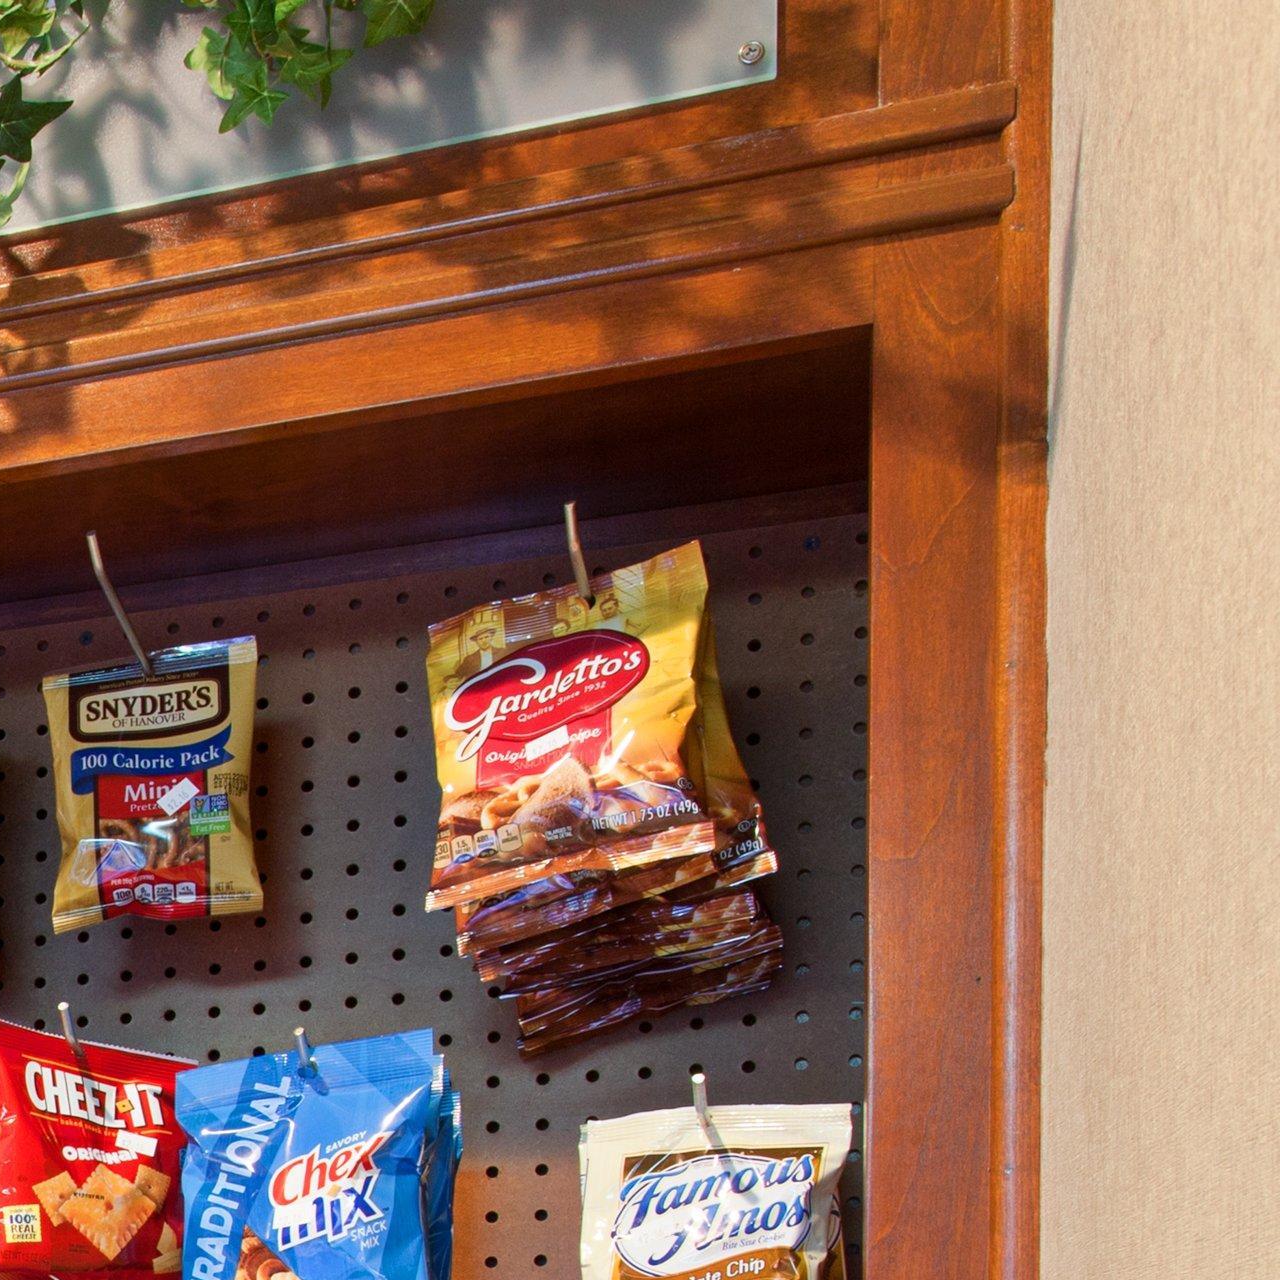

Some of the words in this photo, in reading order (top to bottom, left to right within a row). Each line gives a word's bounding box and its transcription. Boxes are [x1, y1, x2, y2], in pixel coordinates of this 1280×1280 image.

[86, 687, 213, 722] SNYDER'S
[445, 650, 641, 762] Gardetto's
[518, 703, 555, 724] Quality
[584, 680, 607, 694] 1932
[113, 718, 128, 728] OF
[130, 713, 185, 727] HANOVER
[81, 755, 107, 770] 100
[113, 754, 174, 770] Calorie
[181, 746, 220, 766] Pack
[24, 1062, 164, 1130] CHEEZ-IT
[325, 1130, 367, 1154] SAVORY
[272, 1134, 387, 1206] Chex
[620, 1153, 815, 1231] Famous
[10, 1224, 36, 1234] REAL
[350, 1221, 387, 1240] SNACK
[359, 1236, 380, 1250] MIX
[726, 1258, 765, 1280] Chip
